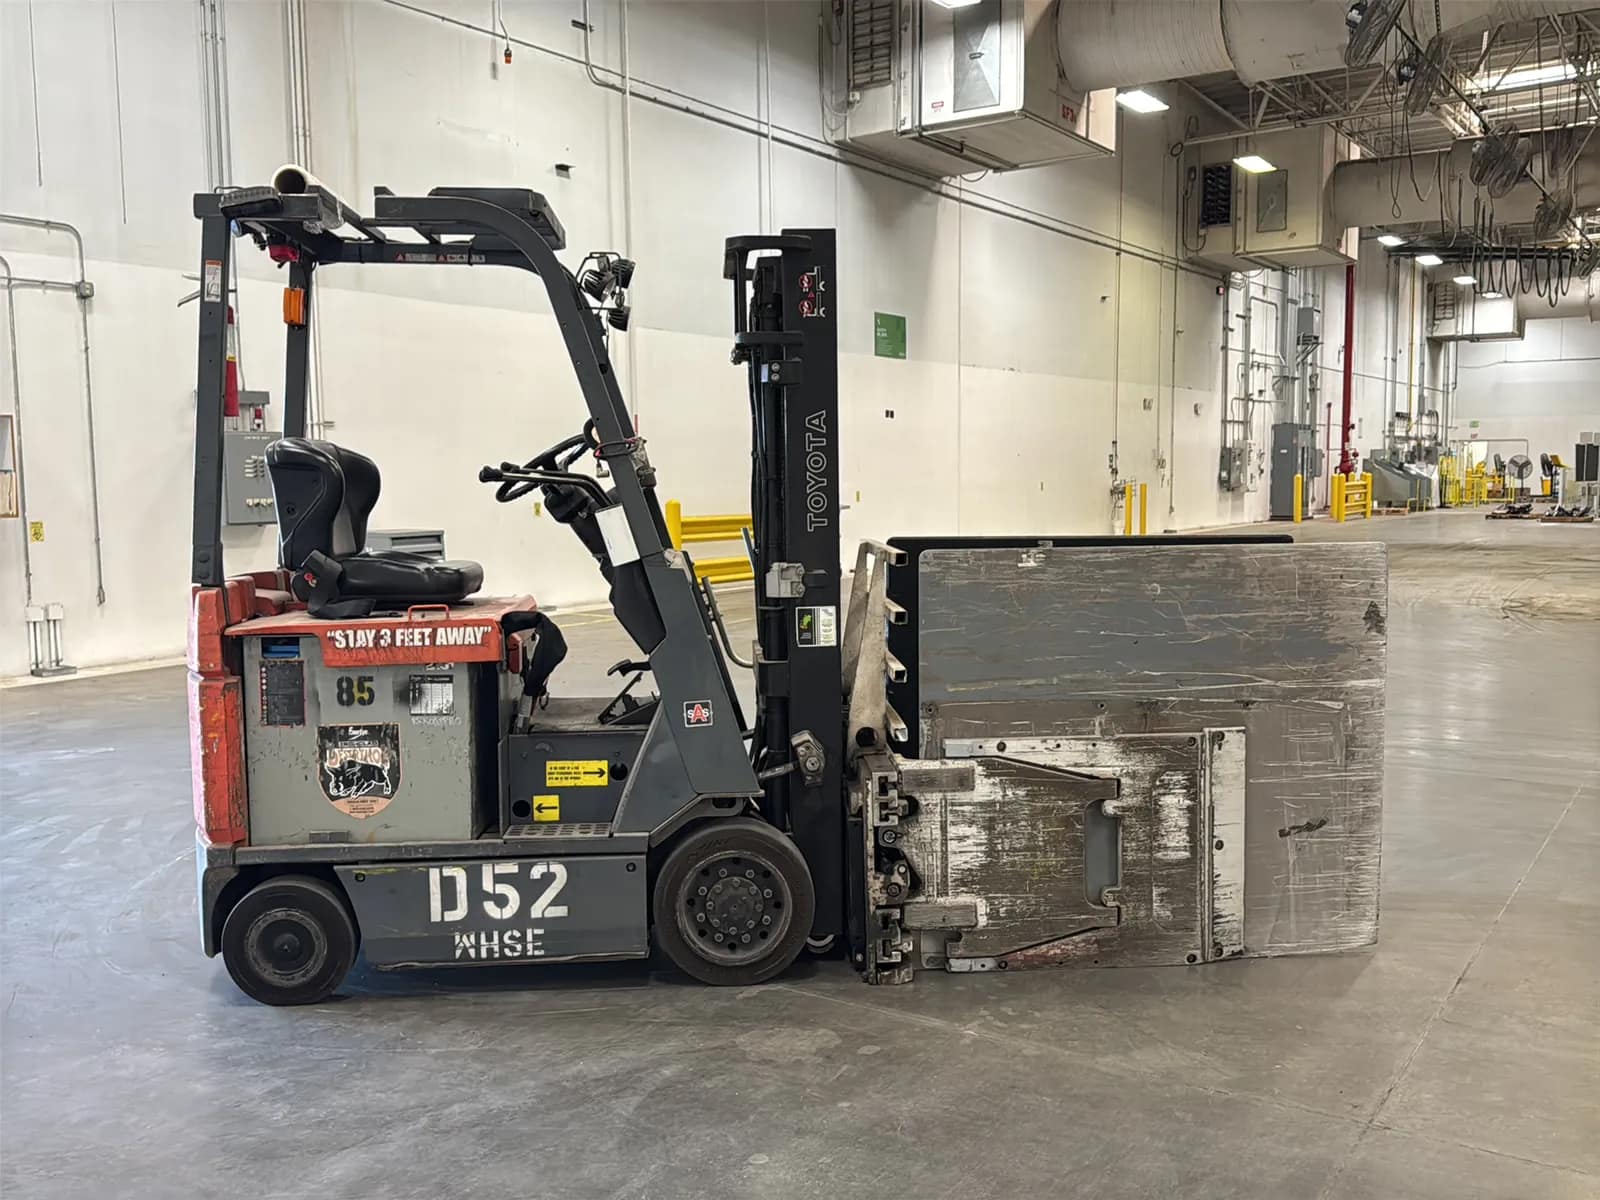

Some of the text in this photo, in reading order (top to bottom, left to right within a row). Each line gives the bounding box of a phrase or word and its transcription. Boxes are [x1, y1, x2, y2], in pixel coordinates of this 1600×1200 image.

[806, 410, 827, 532] TOYOTA
[380, 629, 391, 646] 3
[396, 628, 432, 646] FEET
[337, 676, 375, 706] 85
[429, 861, 568, 922] D52
[455, 928, 544, 959] WHSE
